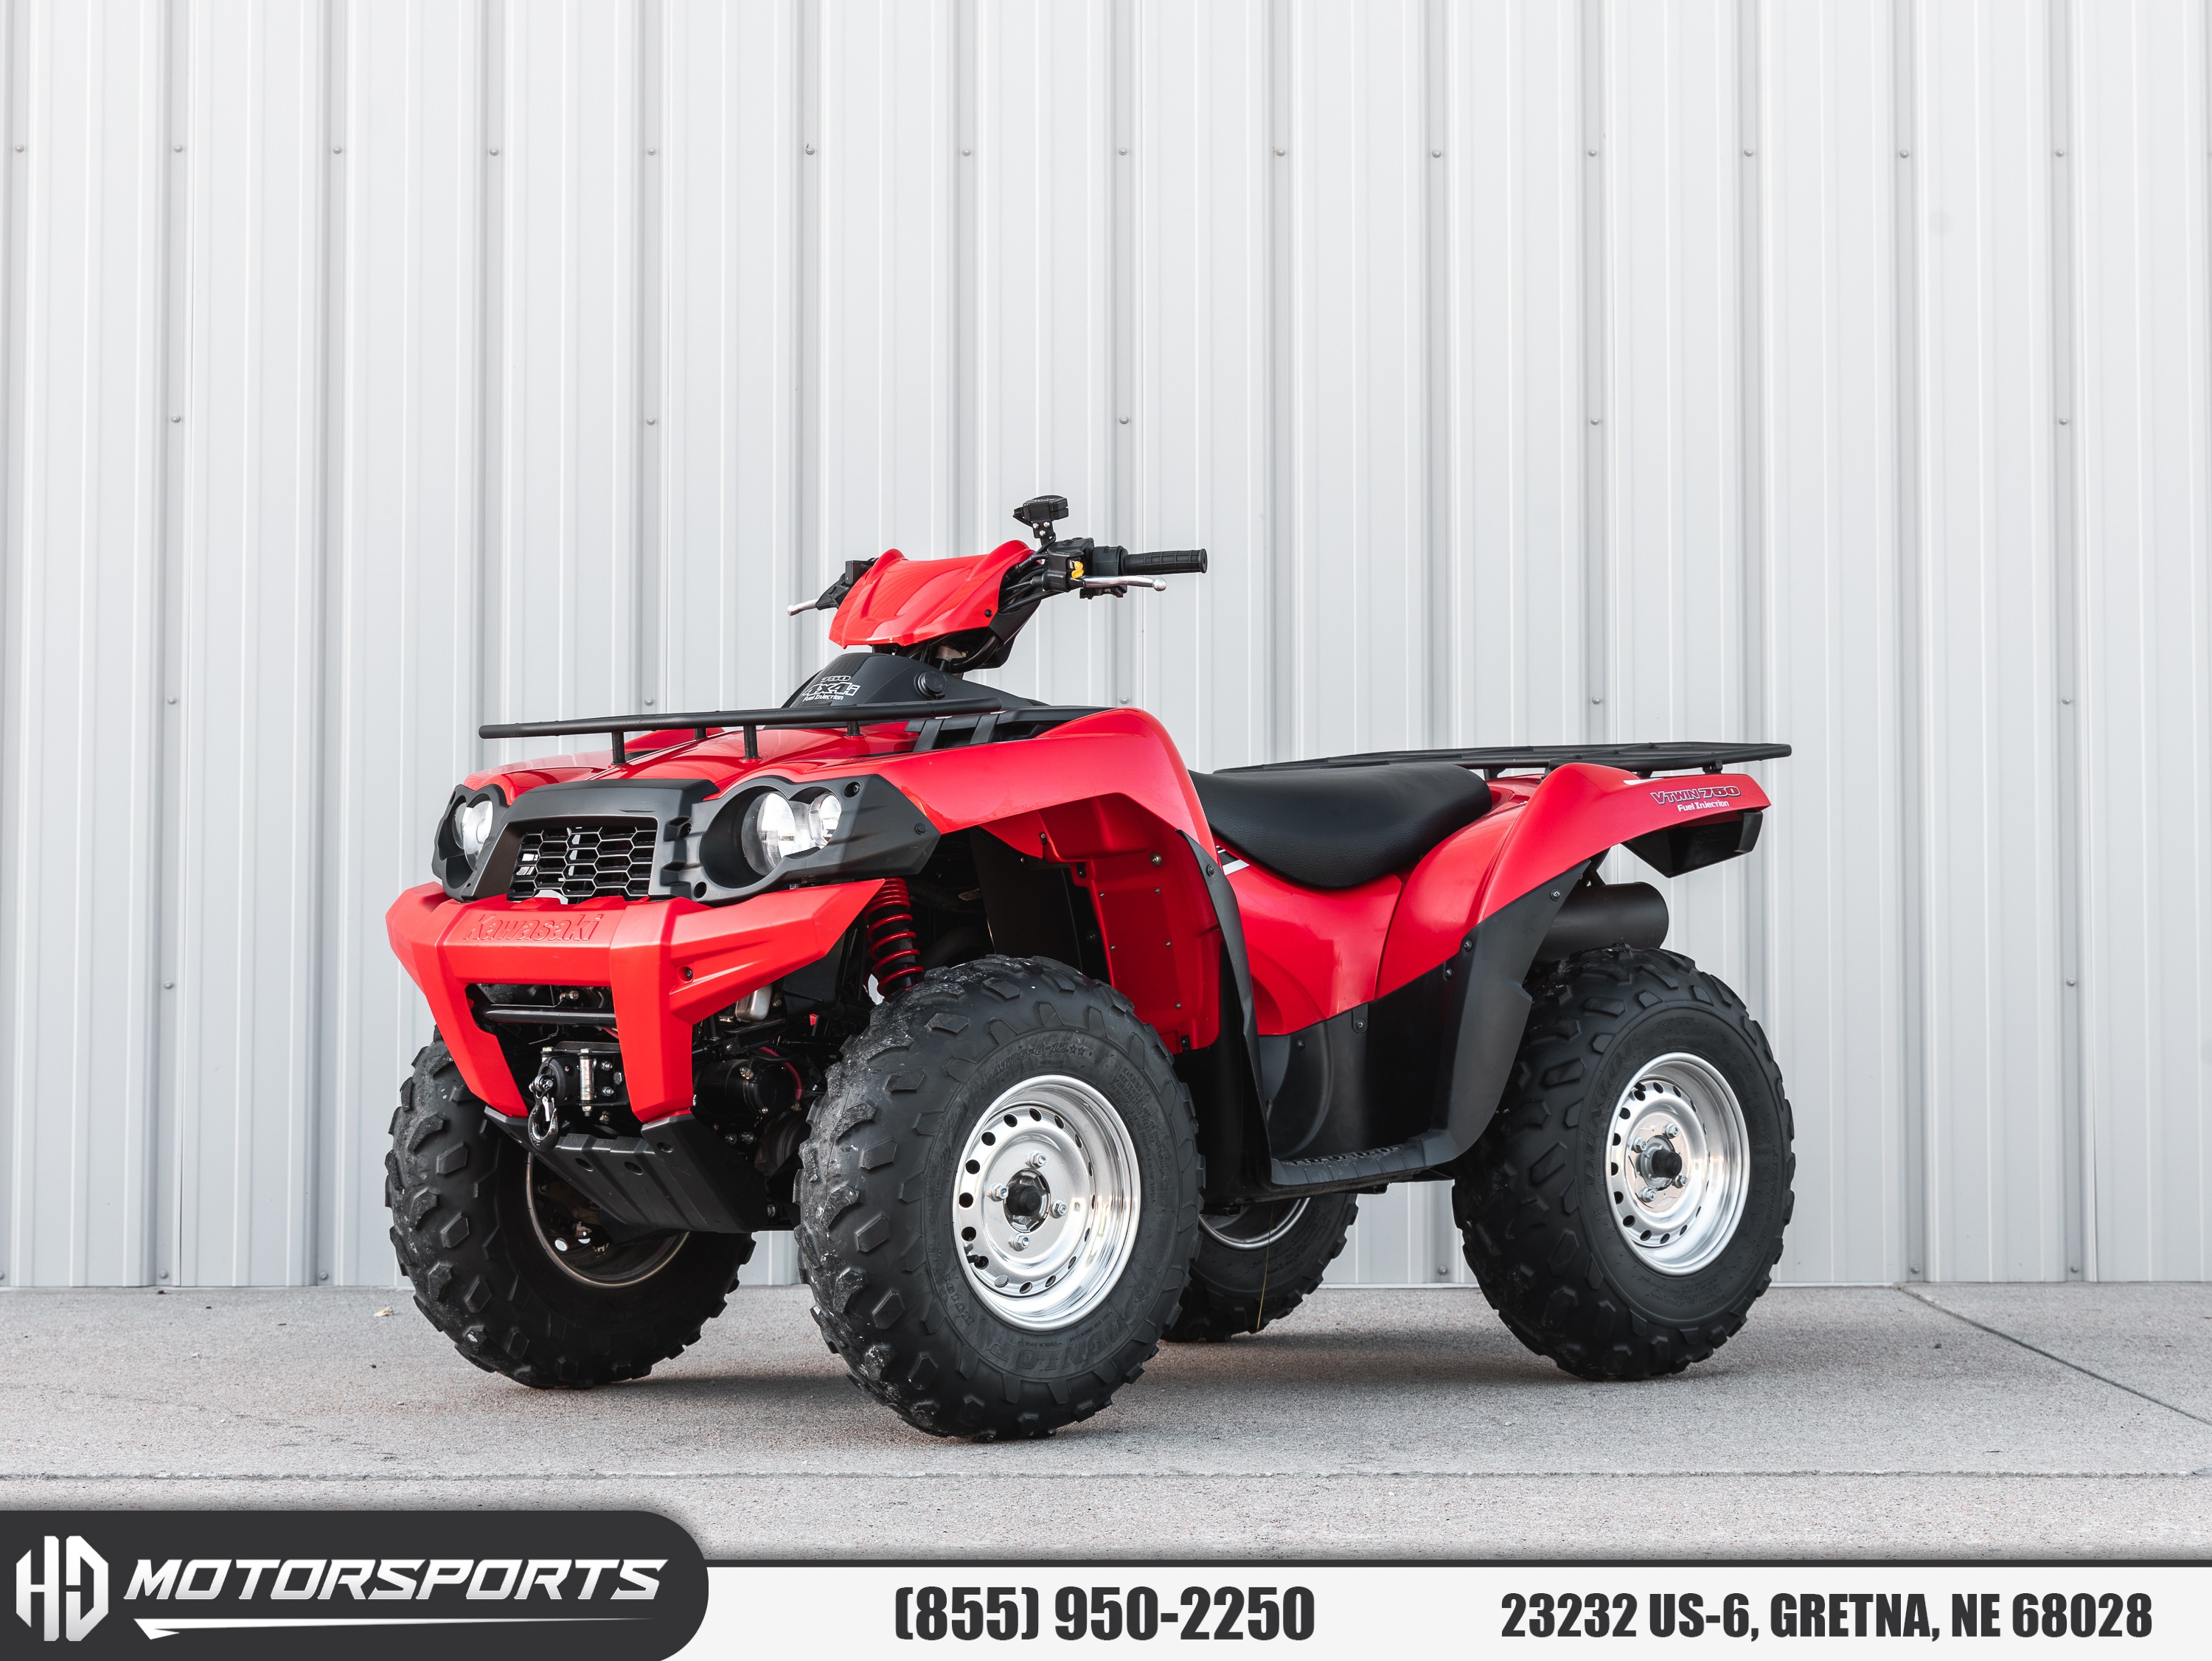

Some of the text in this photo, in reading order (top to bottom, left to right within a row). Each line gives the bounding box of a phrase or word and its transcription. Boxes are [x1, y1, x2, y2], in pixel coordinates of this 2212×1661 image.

[1699, 786, 1741, 798] 750
[1677, 802, 1695, 812] Fuel
[463, 913, 604, 941] Kawasaki
